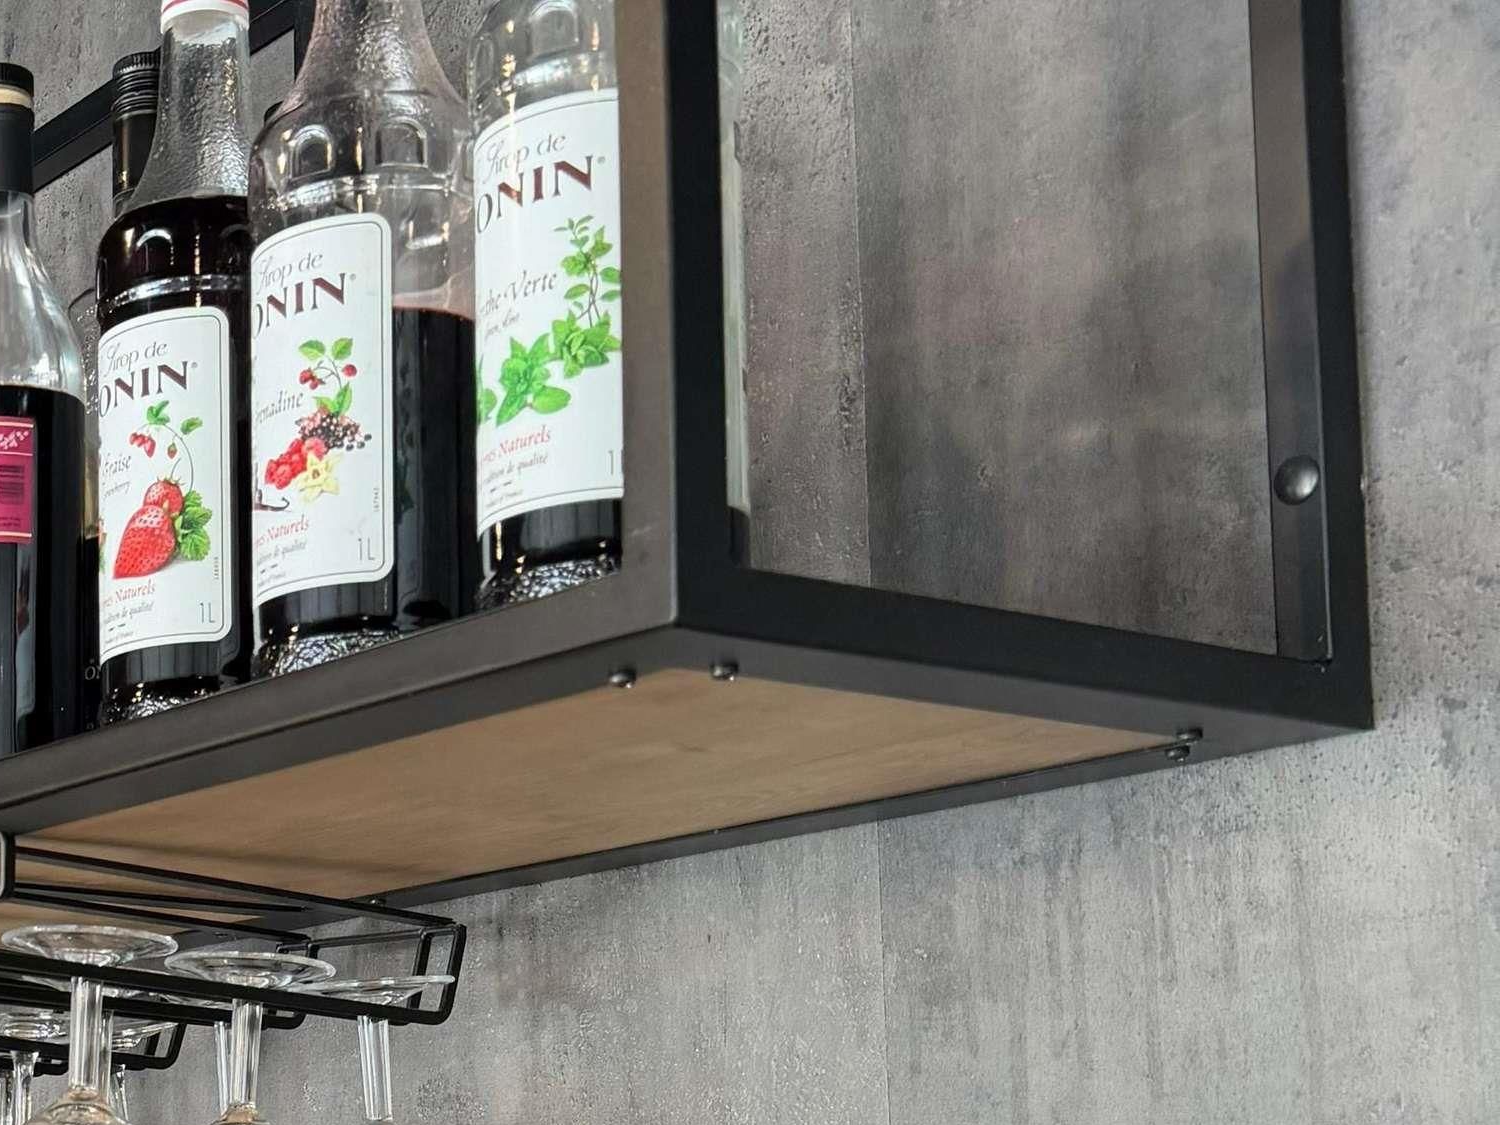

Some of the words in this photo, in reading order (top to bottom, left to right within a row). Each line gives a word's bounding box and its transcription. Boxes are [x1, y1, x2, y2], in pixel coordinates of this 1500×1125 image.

[537, 133, 566, 155] de
[477, 155, 593, 235] ONIN
[298, 251, 323, 272] de
[504, 270, 557, 302] Verte
[144, 341, 168, 359] de
[100, 360, 188, 418] ONIN
[499, 424, 551, 459] Naturels
[114, 578, 157, 605] Naturels
[199, 602, 216, 624] 1L
